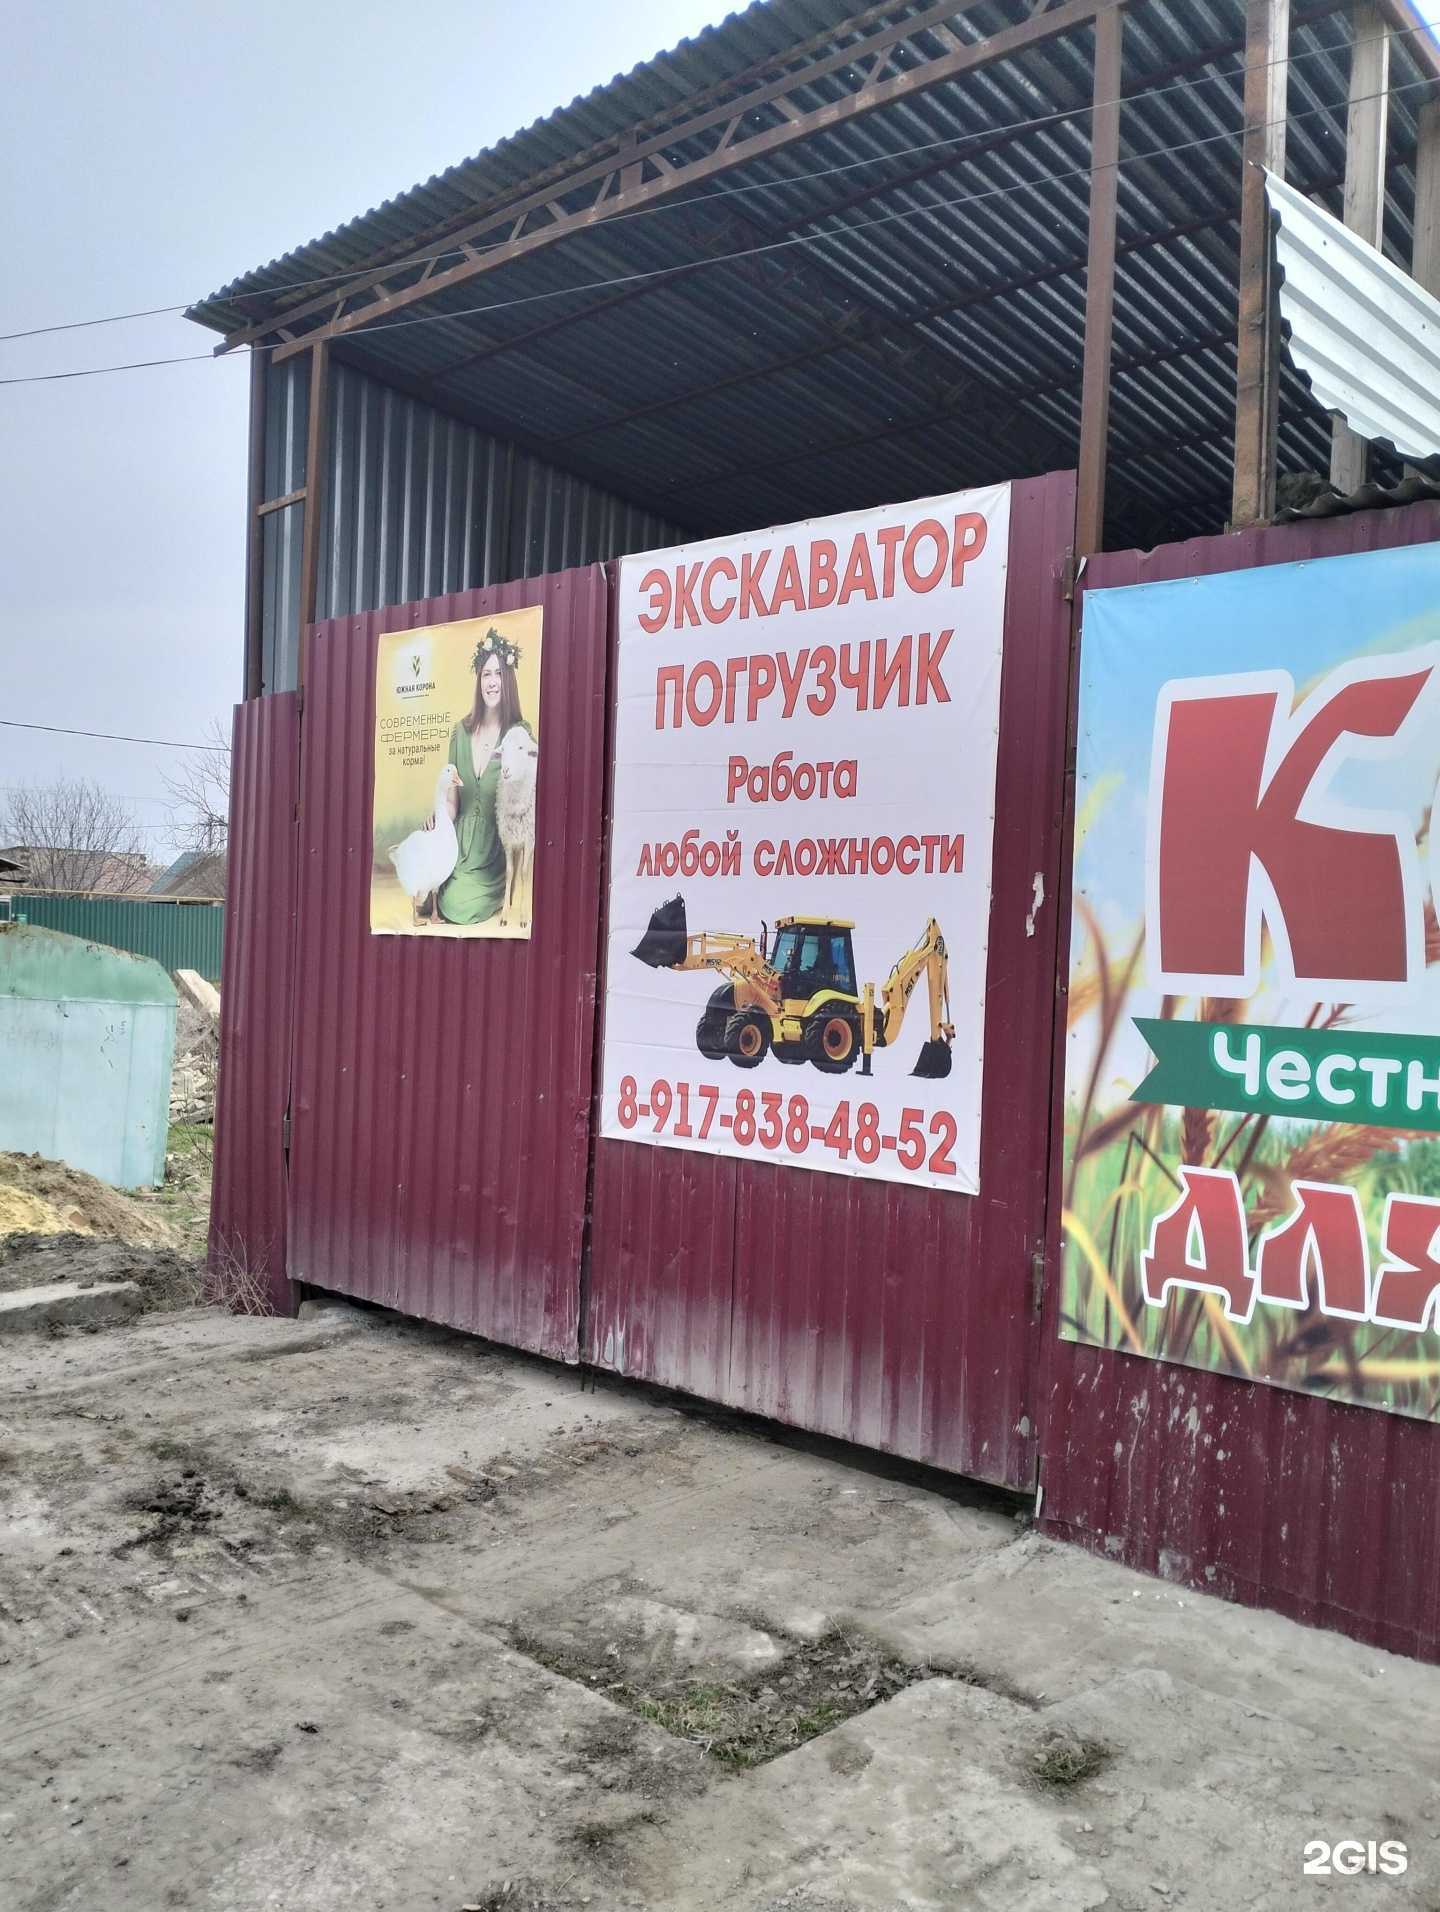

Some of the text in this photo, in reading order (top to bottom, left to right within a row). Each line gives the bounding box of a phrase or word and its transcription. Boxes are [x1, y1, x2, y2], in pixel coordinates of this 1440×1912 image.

[637, 511, 989, 634] ЭКСКАВАТОР
[655, 629, 956, 731] ПОГРУЗЧИК
[380, 712, 451, 730] СОВРЕМЕННЫЕ
[380, 727, 450, 743] ФЕРМЕРЫ
[397, 744, 441, 757] натуральные
[726, 750, 859, 804] Работа
[636, 828, 966, 878] любой сложности
[616, 1074, 958, 1177] 8-917-838-48-52
